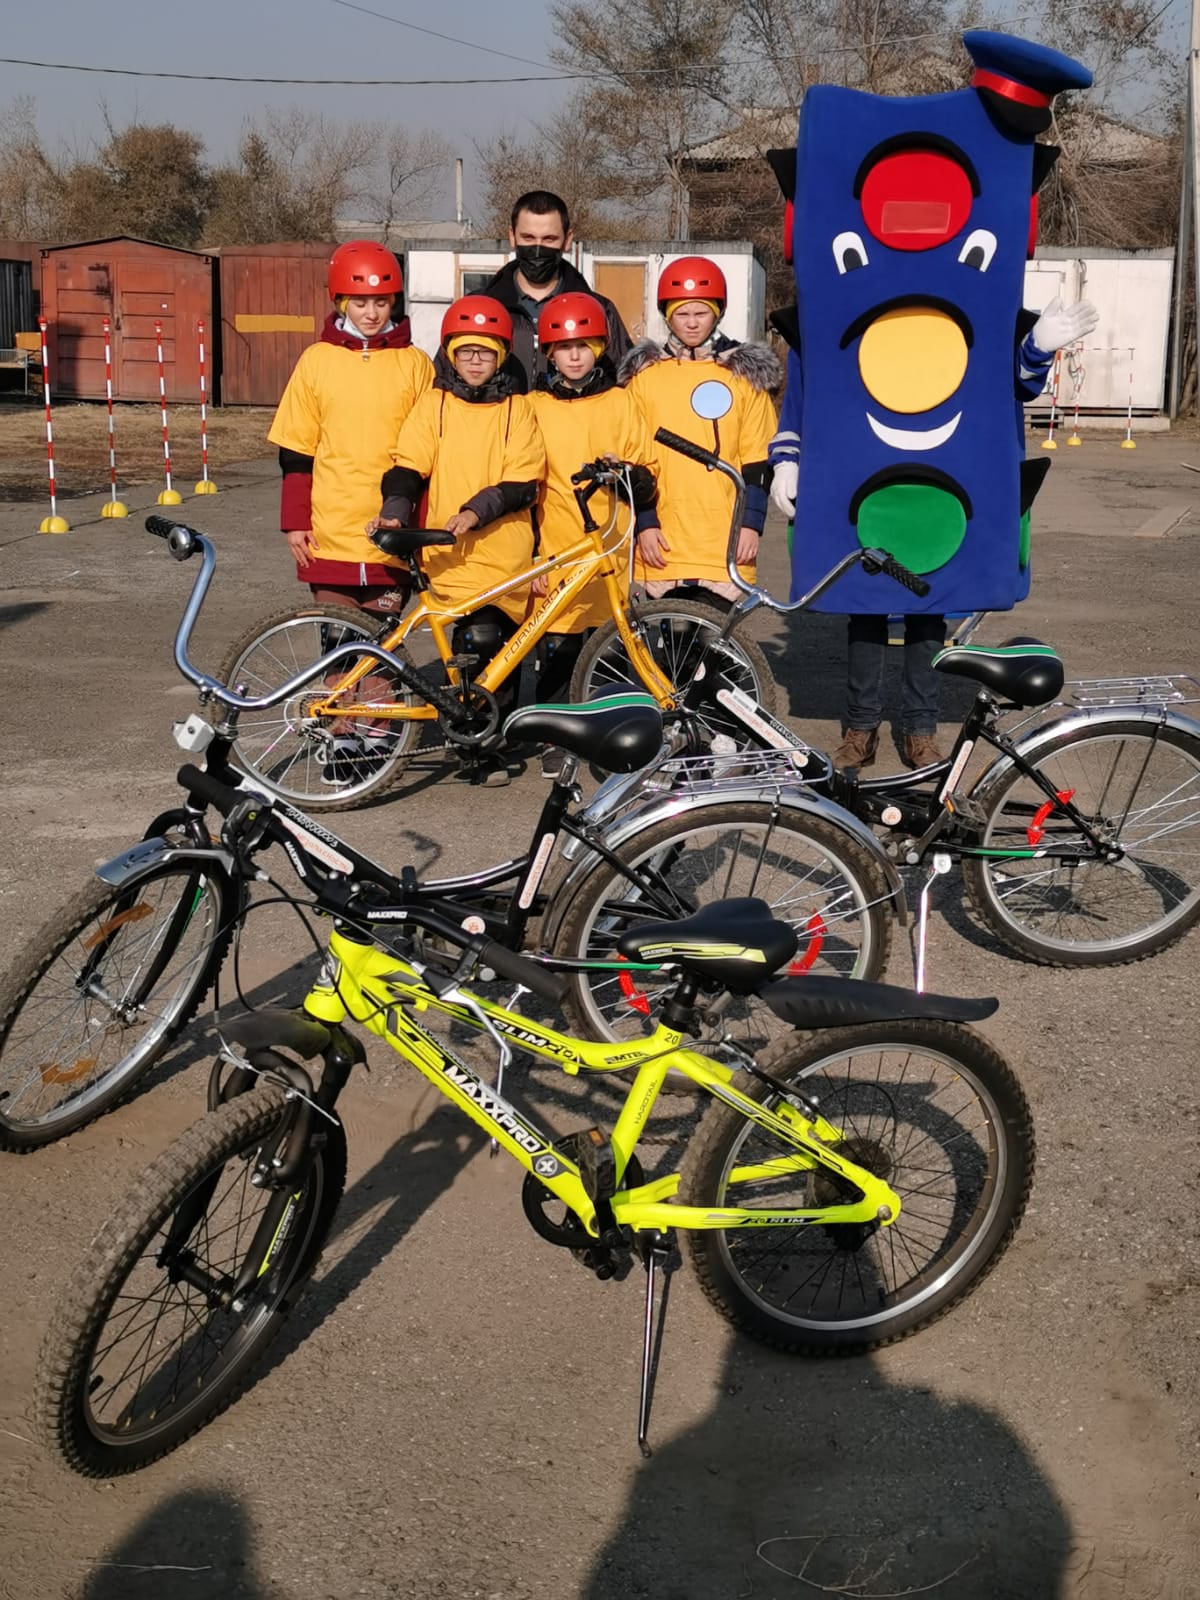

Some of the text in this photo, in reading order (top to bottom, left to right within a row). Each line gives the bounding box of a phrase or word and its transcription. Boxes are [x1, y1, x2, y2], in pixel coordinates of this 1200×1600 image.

[503, 589, 562, 663] FORWARD
[367, 910, 408, 920] MAXXPRO
[491, 1019, 547, 1048] SLIM
[665, 1032, 680, 1046] 20
[443, 1065, 542, 1154] MAXXPRO
